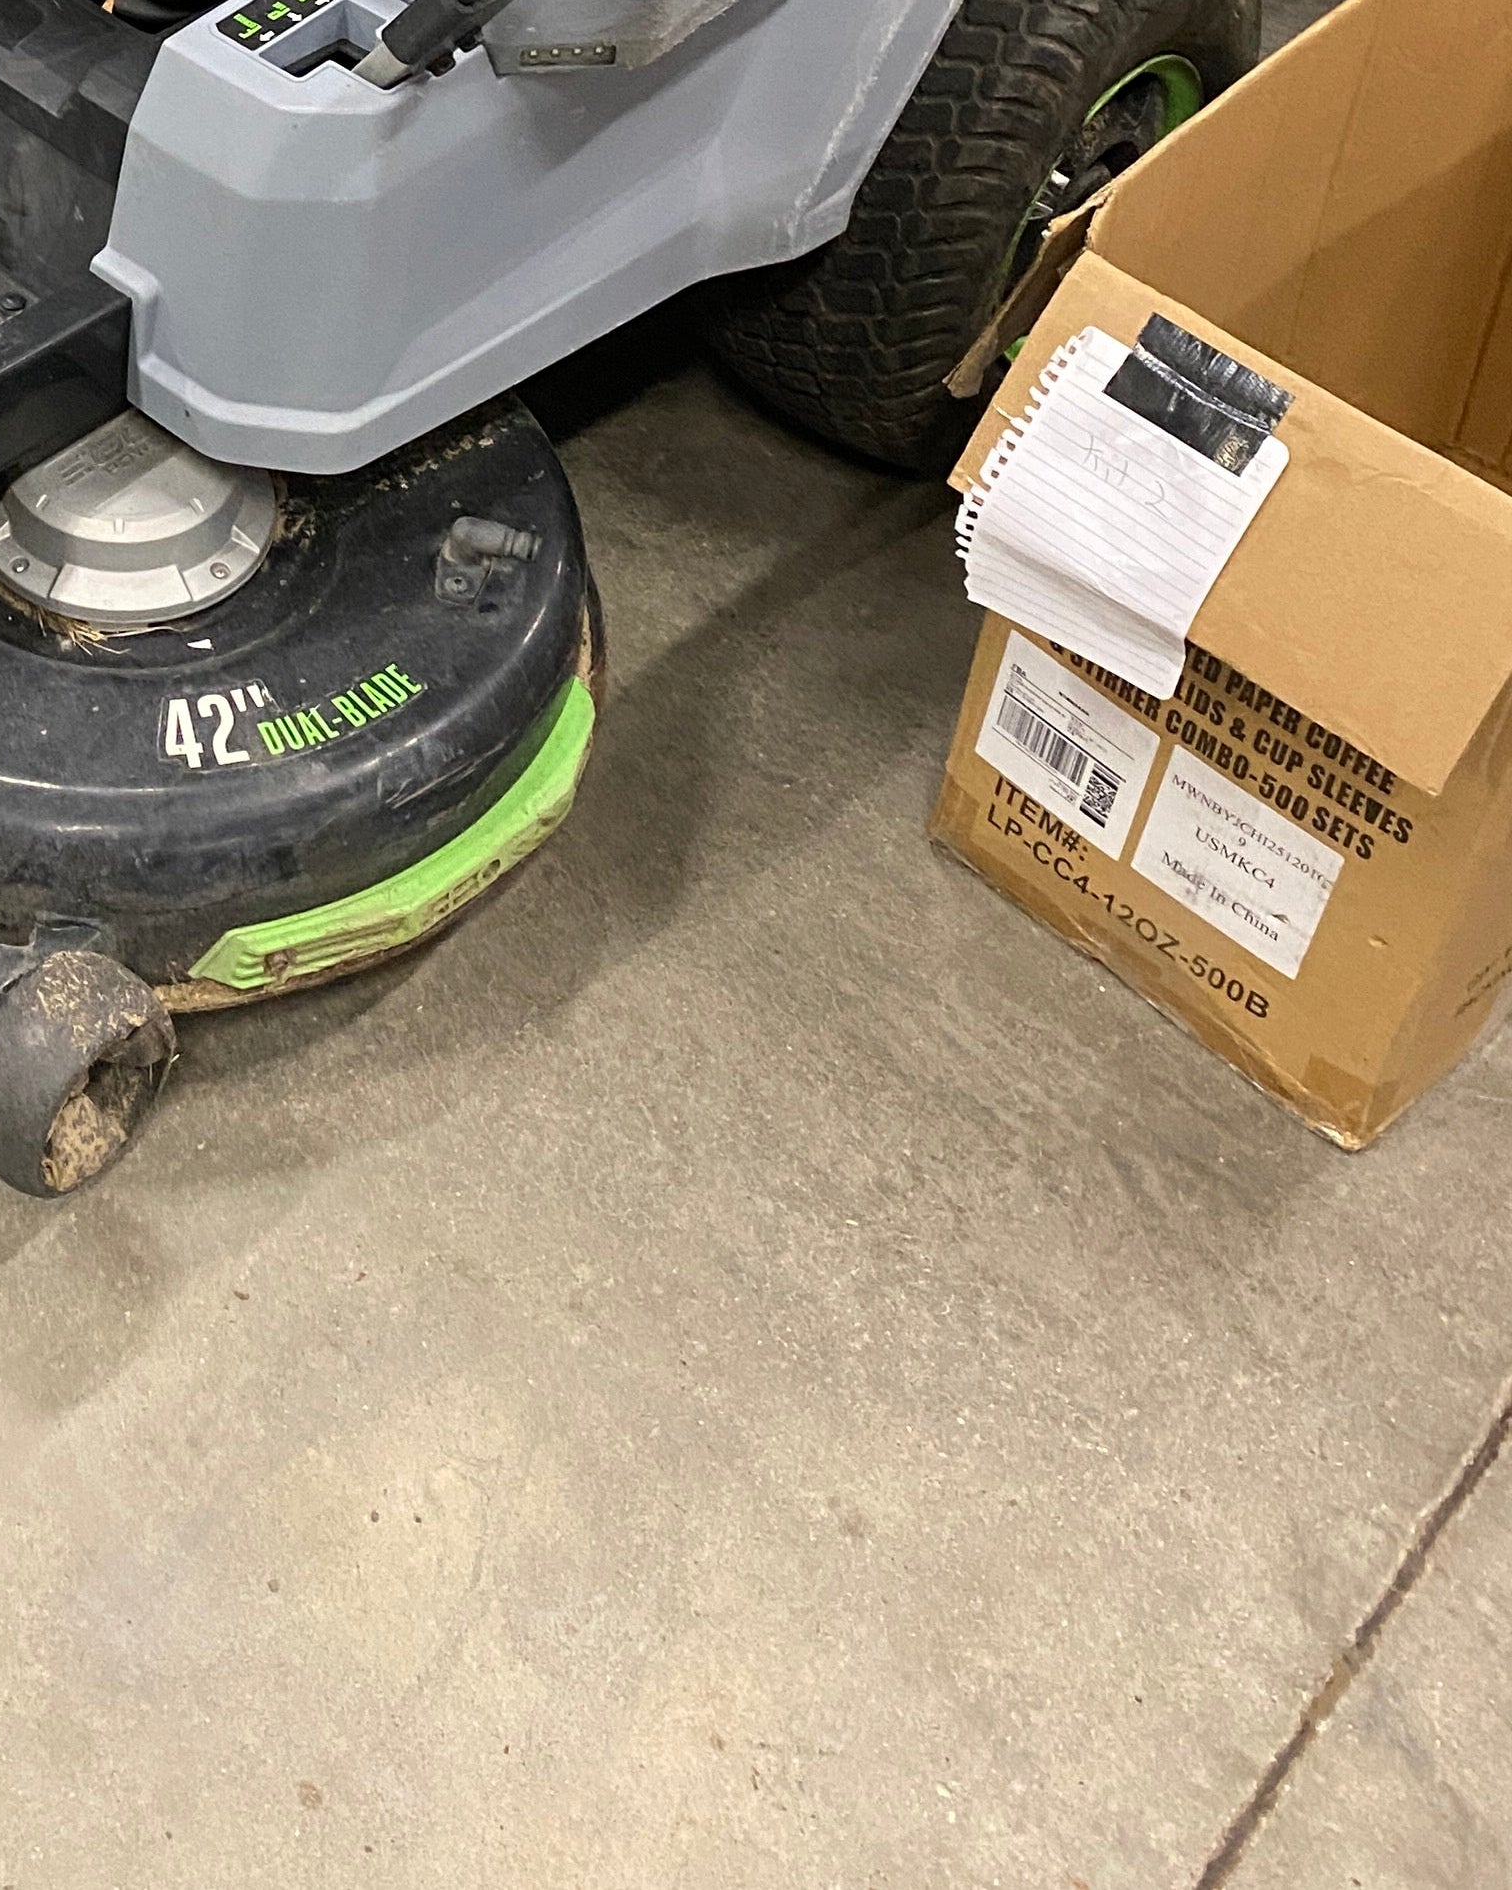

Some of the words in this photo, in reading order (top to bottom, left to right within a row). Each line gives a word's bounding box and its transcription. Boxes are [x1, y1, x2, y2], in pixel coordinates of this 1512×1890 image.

[165, 684, 266, 769] 42"
[257, 662, 424, 757] DUAL-BLADE
[1225, 668, 1303, 735] PAPER
[1305, 721, 1398, 795] COFFEE
[993, 774, 1089, 862] ITEM#:
[1165, 709, 1309, 821] COMBO-500
[1312, 806, 1375, 860] SETS
[1229, 717, 1246, 742] &
[1254, 729, 1303, 773] CUP
[1307, 764, 1413, 844] SLEEVES
[1162, 851, 1206, 891] Made
[1210, 884, 1227, 905] In
[1231, 901, 1280, 942] China
[1195, 826, 1277, 890] USMKC4
